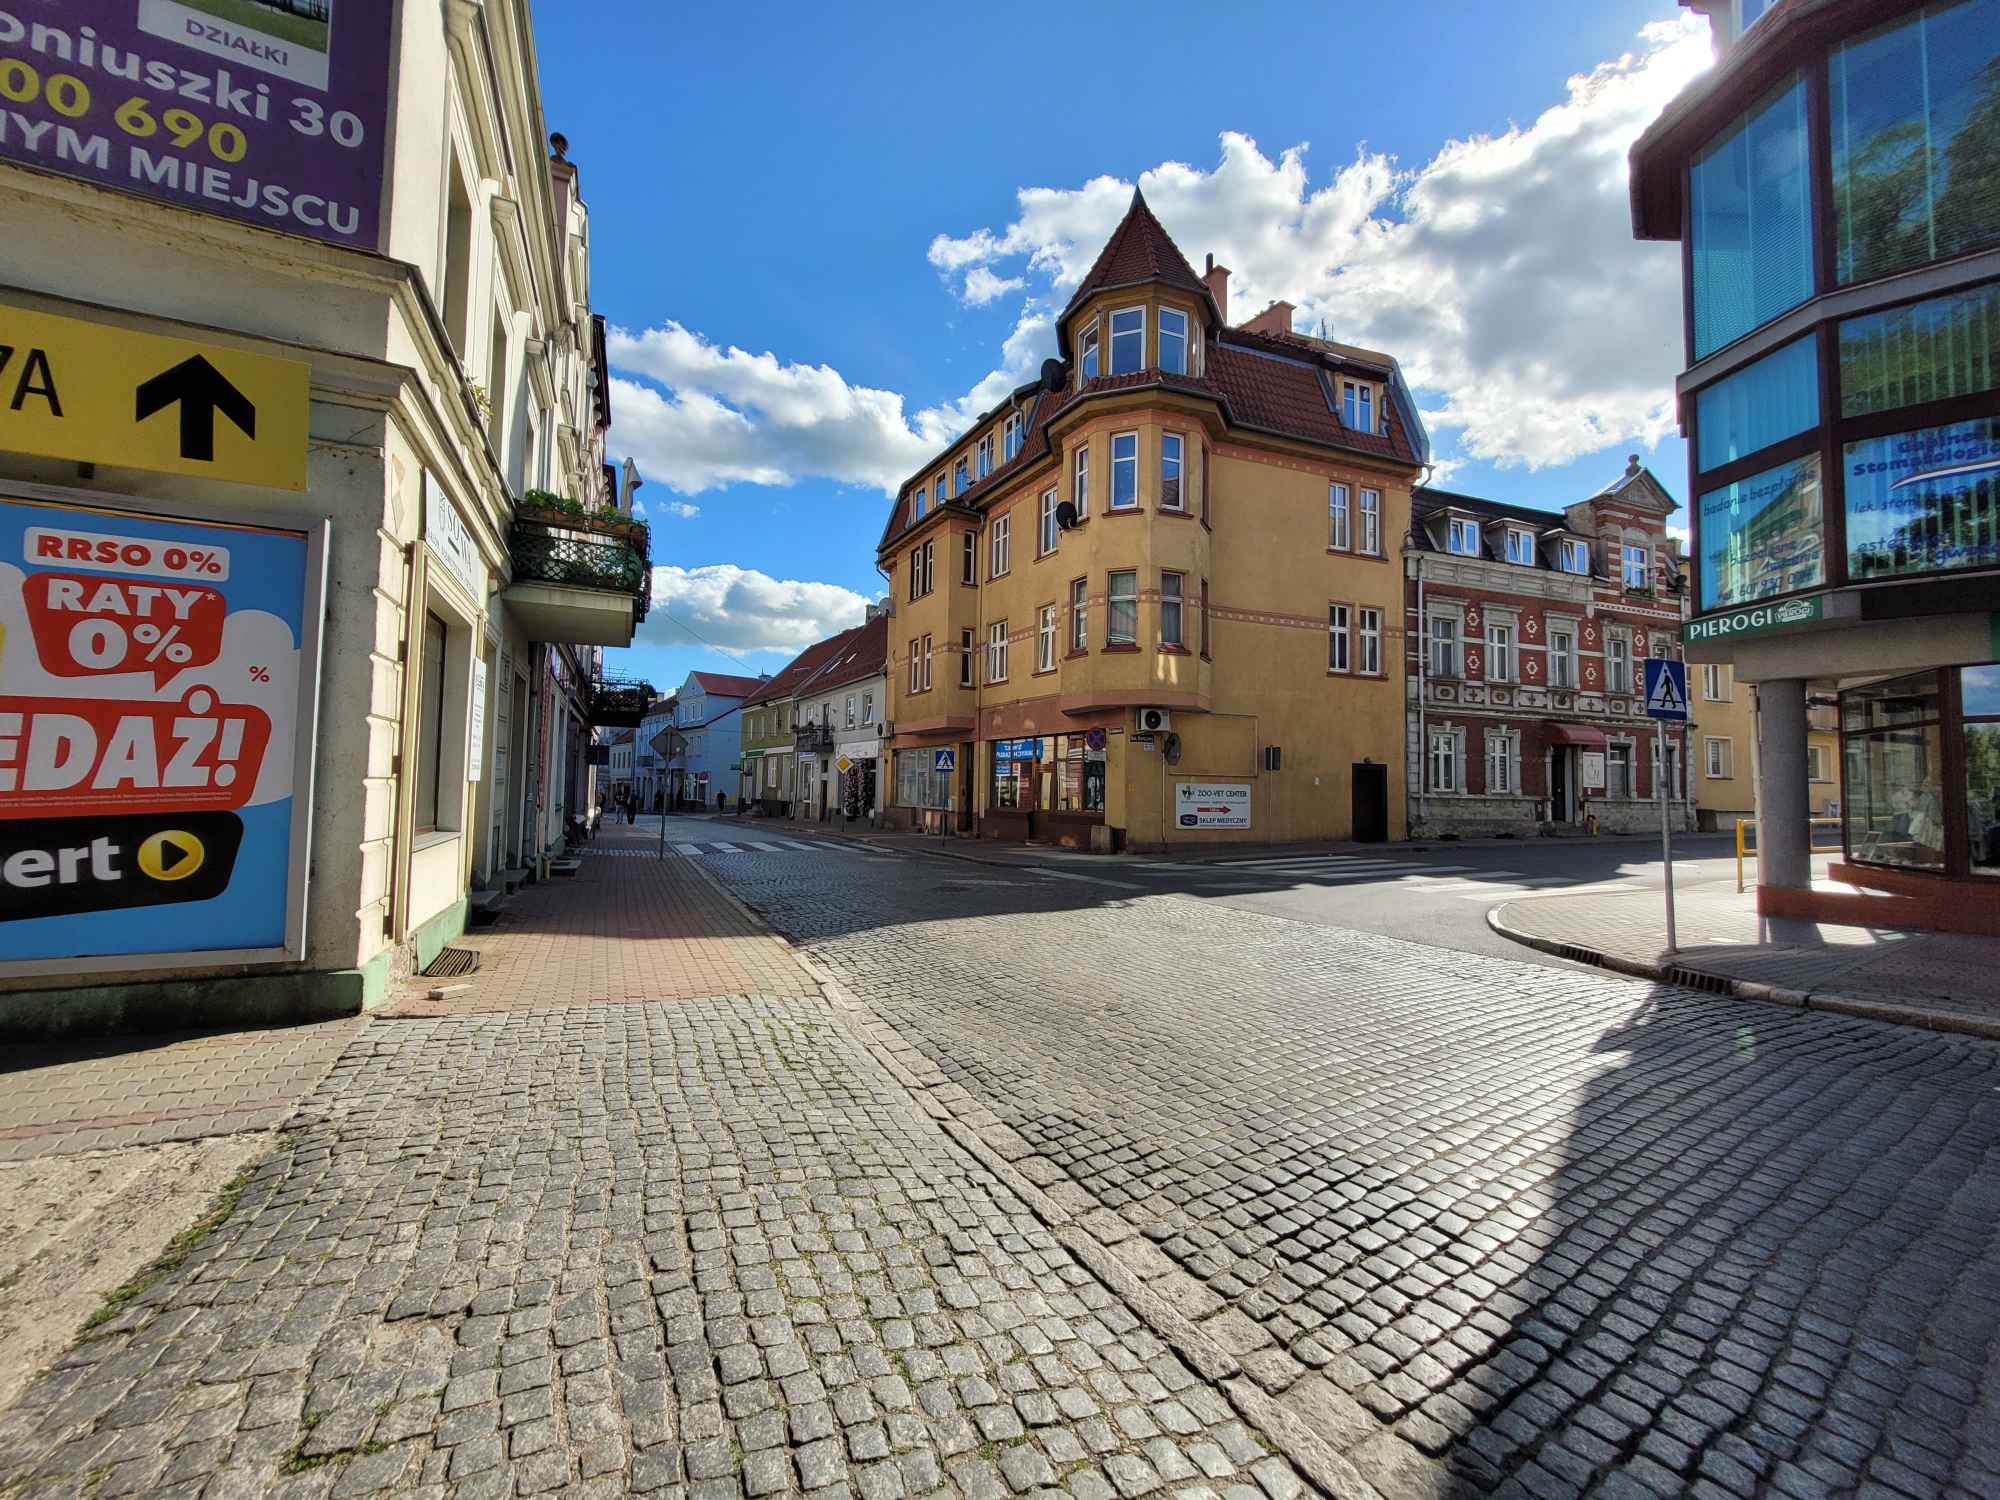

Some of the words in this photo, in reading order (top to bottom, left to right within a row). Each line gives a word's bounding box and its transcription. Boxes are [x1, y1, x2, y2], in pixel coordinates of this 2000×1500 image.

[186, 18, 289, 67] DZIAŁKI
[114, 96, 247, 162] 690
[289, 98, 364, 147] 30
[0, 109, 109, 170] YM
[130, 147, 359, 234] MIEJSCU
[37, 535, 151, 566] RRSO
[163, 548, 222, 574] 0%
[68, 618, 193, 669] 0%
[1690, 608, 1772, 639] PIEROGI
[249, 665, 270, 683] %
[4, 836, 121, 887] ert
